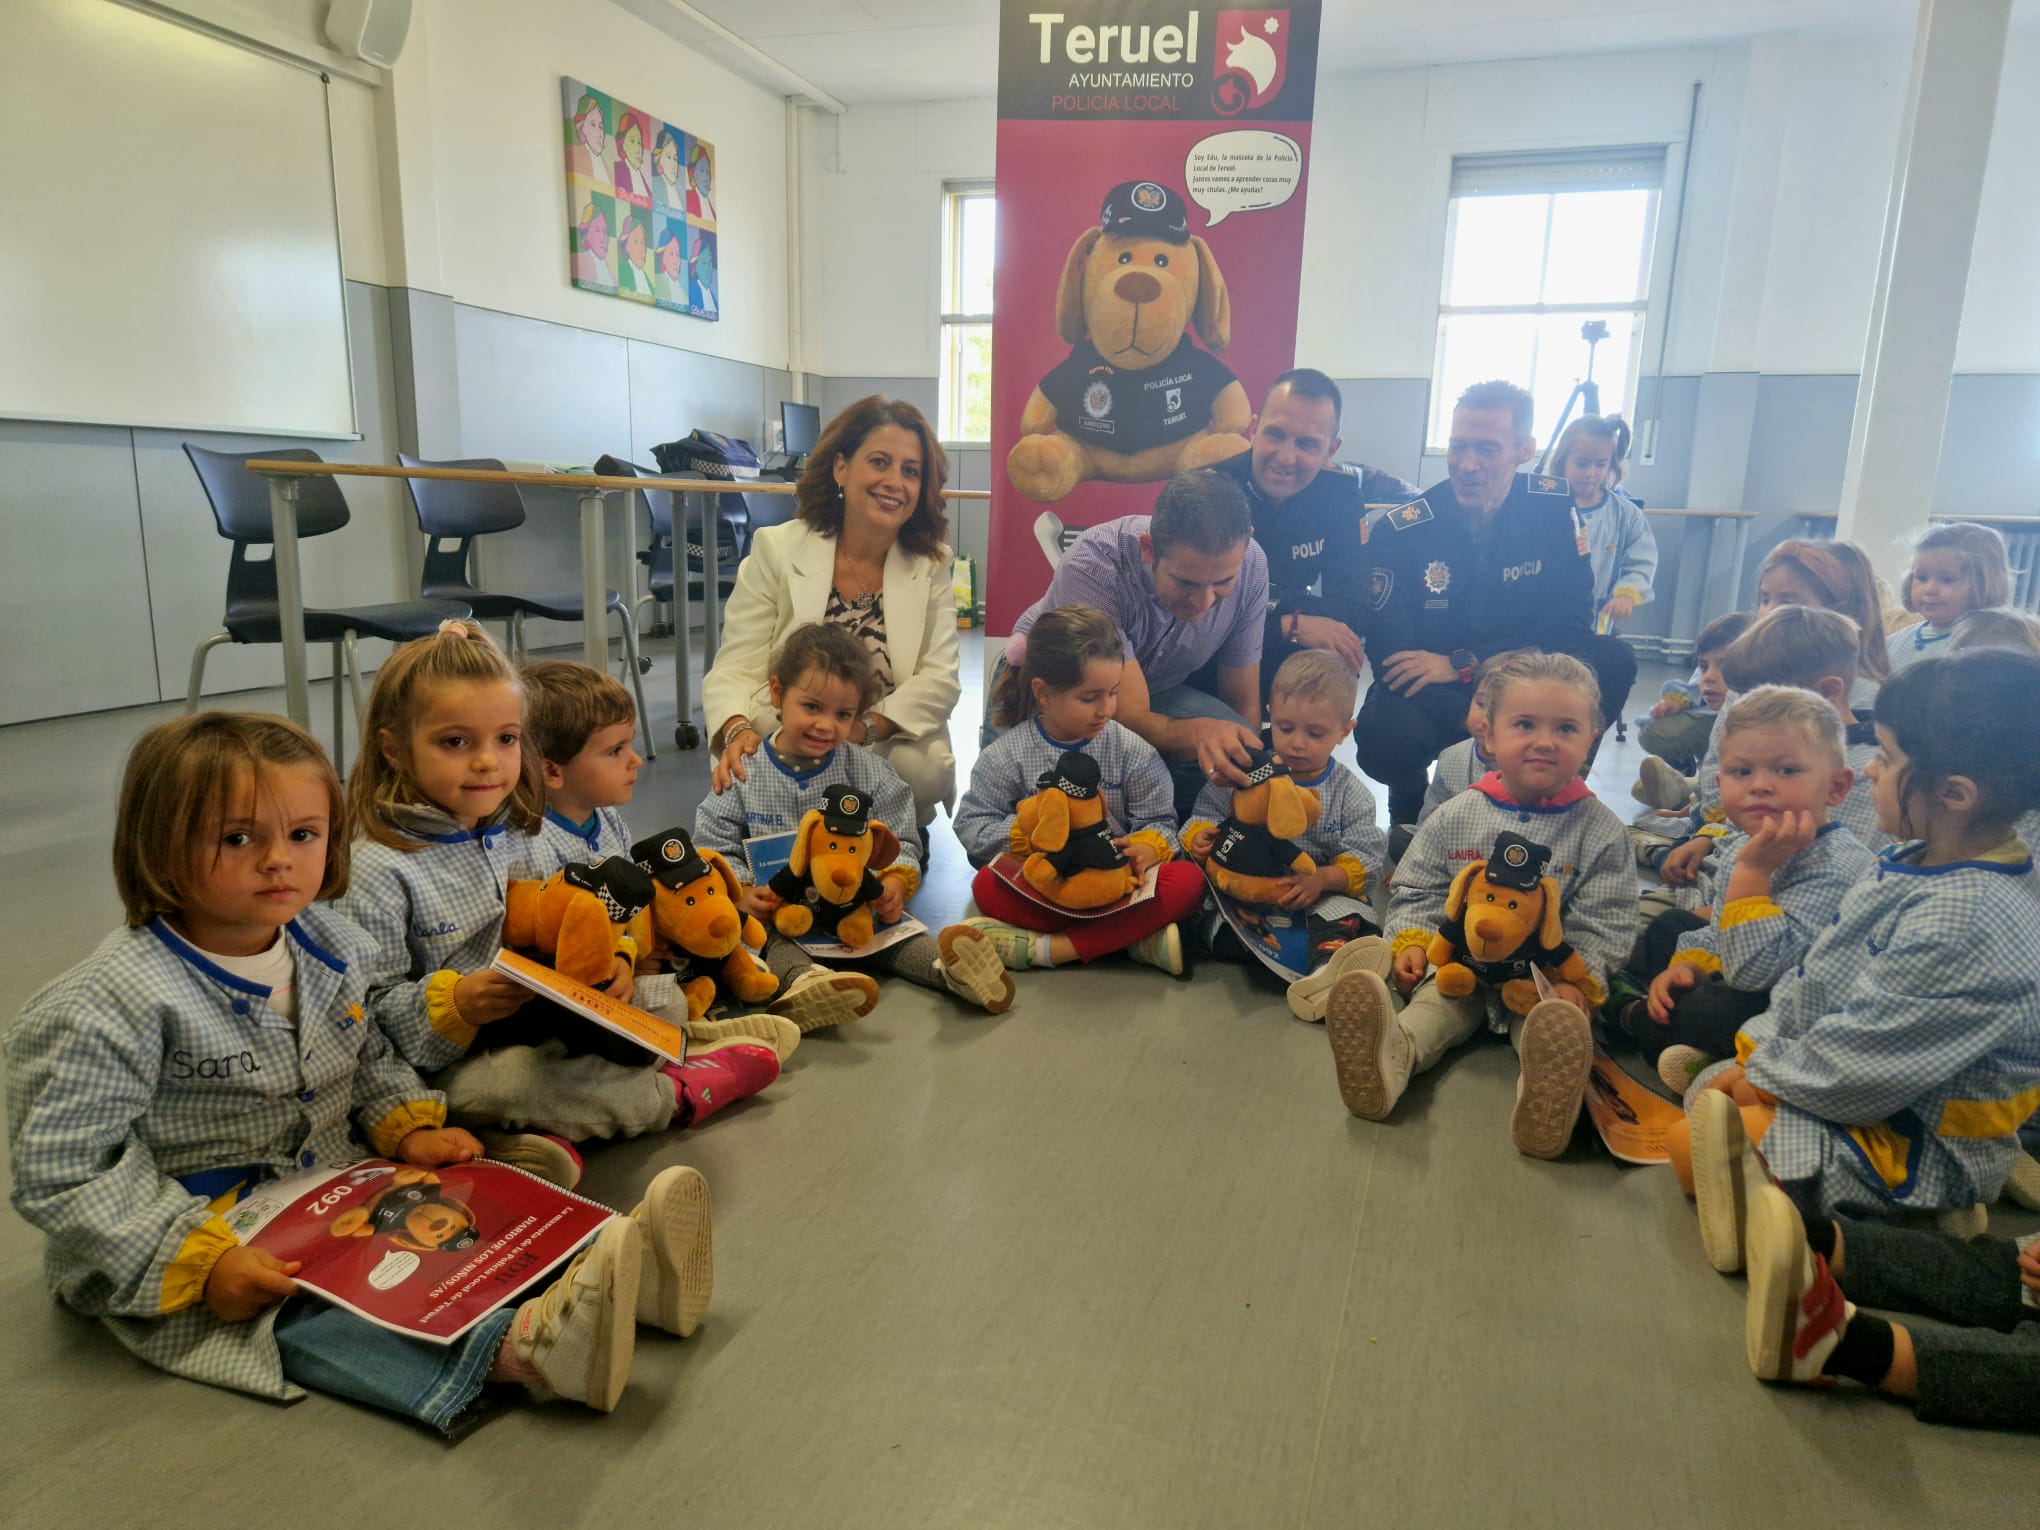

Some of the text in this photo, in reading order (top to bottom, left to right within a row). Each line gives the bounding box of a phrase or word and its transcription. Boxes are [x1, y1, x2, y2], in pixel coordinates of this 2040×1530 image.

[1028, 10, 1200, 64] Teruel
[1068, 72, 1194, 88] AYUNTAMIENTO
[1052, 92, 1182, 112] POLICÍA LOCAL
[1193, 164, 1208, 172] Local
[1192, 175, 1210, 183] Juntos
[1235, 175, 1261, 184] aprender
[1227, 186, 1239, 194] ¿Me
[1240, 186, 1264, 194] ayudas?
[1162, 412, 1188, 426] TERUEL
[1447, 849, 1482, 860] LAURA
[173, 1051, 261, 1079] Sara
[306, 1185, 352, 1215] 092
[560, 1206, 574, 1215] La
[504, 1215, 539, 1241] DIARIO
[530, 1213, 562, 1239] mascota
[490, 1237, 507, 1251] DE
[512, 1244, 524, 1254] la
[521, 1238, 533, 1248] de
[473, 1247, 493, 1265] LOS
[495, 1251, 540, 1284] EDU
[429, 1262, 477, 1299] NIÑOS/AS
[464, 1270, 489, 1293] Local
[450, 1291, 464, 1303] de
[419, 1297, 452, 1325] Teruel
